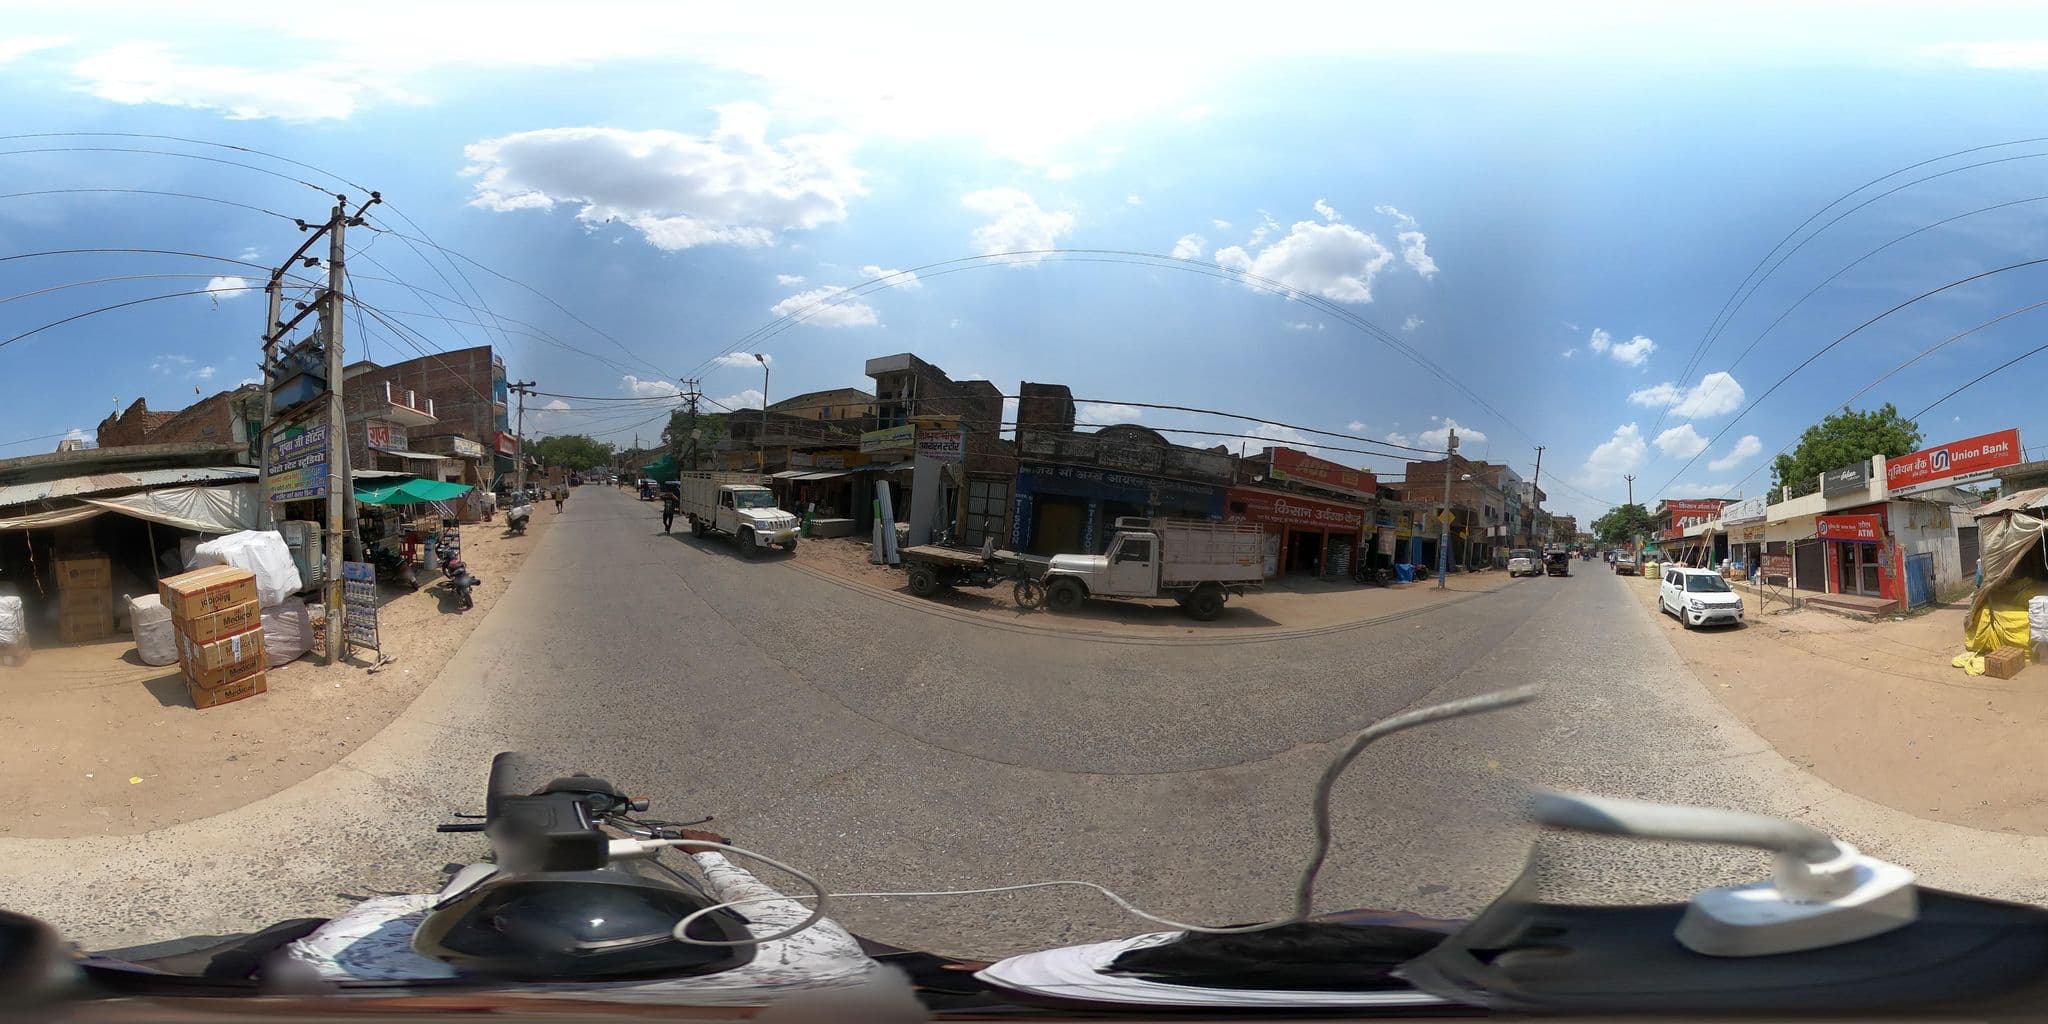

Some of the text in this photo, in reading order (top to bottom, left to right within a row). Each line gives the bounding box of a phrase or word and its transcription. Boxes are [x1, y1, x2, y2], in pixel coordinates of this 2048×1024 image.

[368, 425, 390, 447] गुप्ता
[1951, 441, 2009, 462] Union Bank
[1887, 457, 1928, 480] यूनियन बैंक
[1273, 499, 1313, 519] किसान
[1857, 529, 1874, 538] ATM
